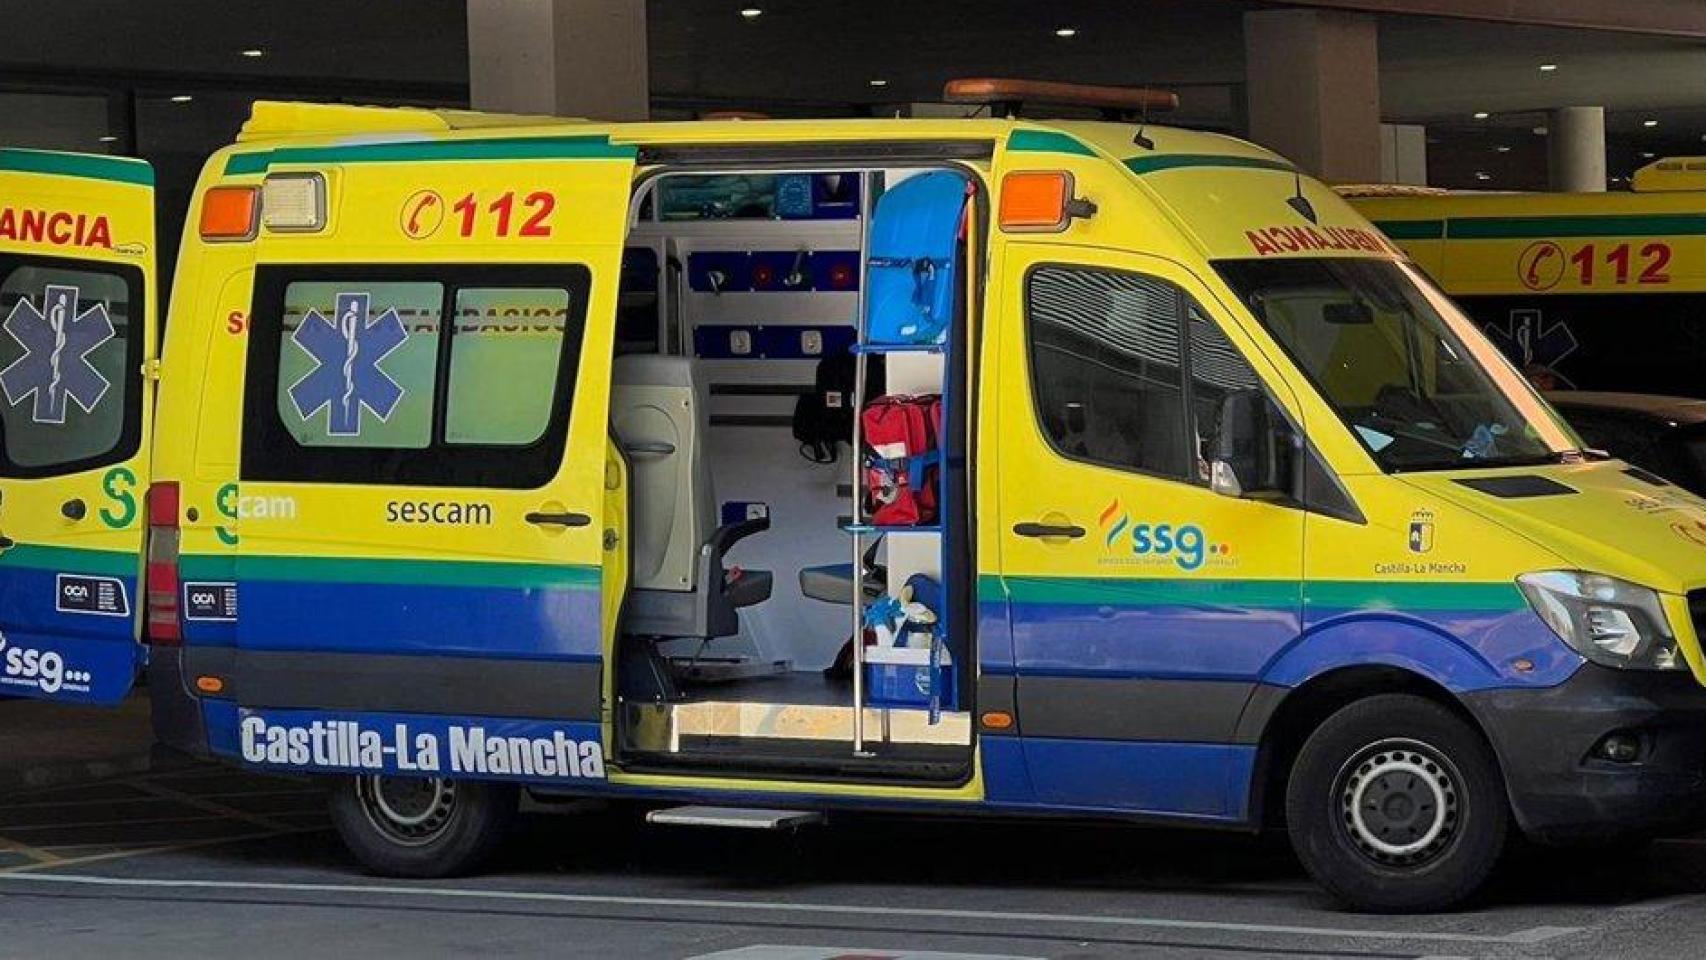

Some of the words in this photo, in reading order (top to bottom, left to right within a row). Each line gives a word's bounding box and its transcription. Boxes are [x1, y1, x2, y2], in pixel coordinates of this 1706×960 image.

[453, 190, 556, 239] 112
[1571, 242, 1673, 286] 112
[386, 499, 492, 525] sescam
[240, 716, 441, 771] Castilla-La
[448, 726, 605, 779] Mancha
